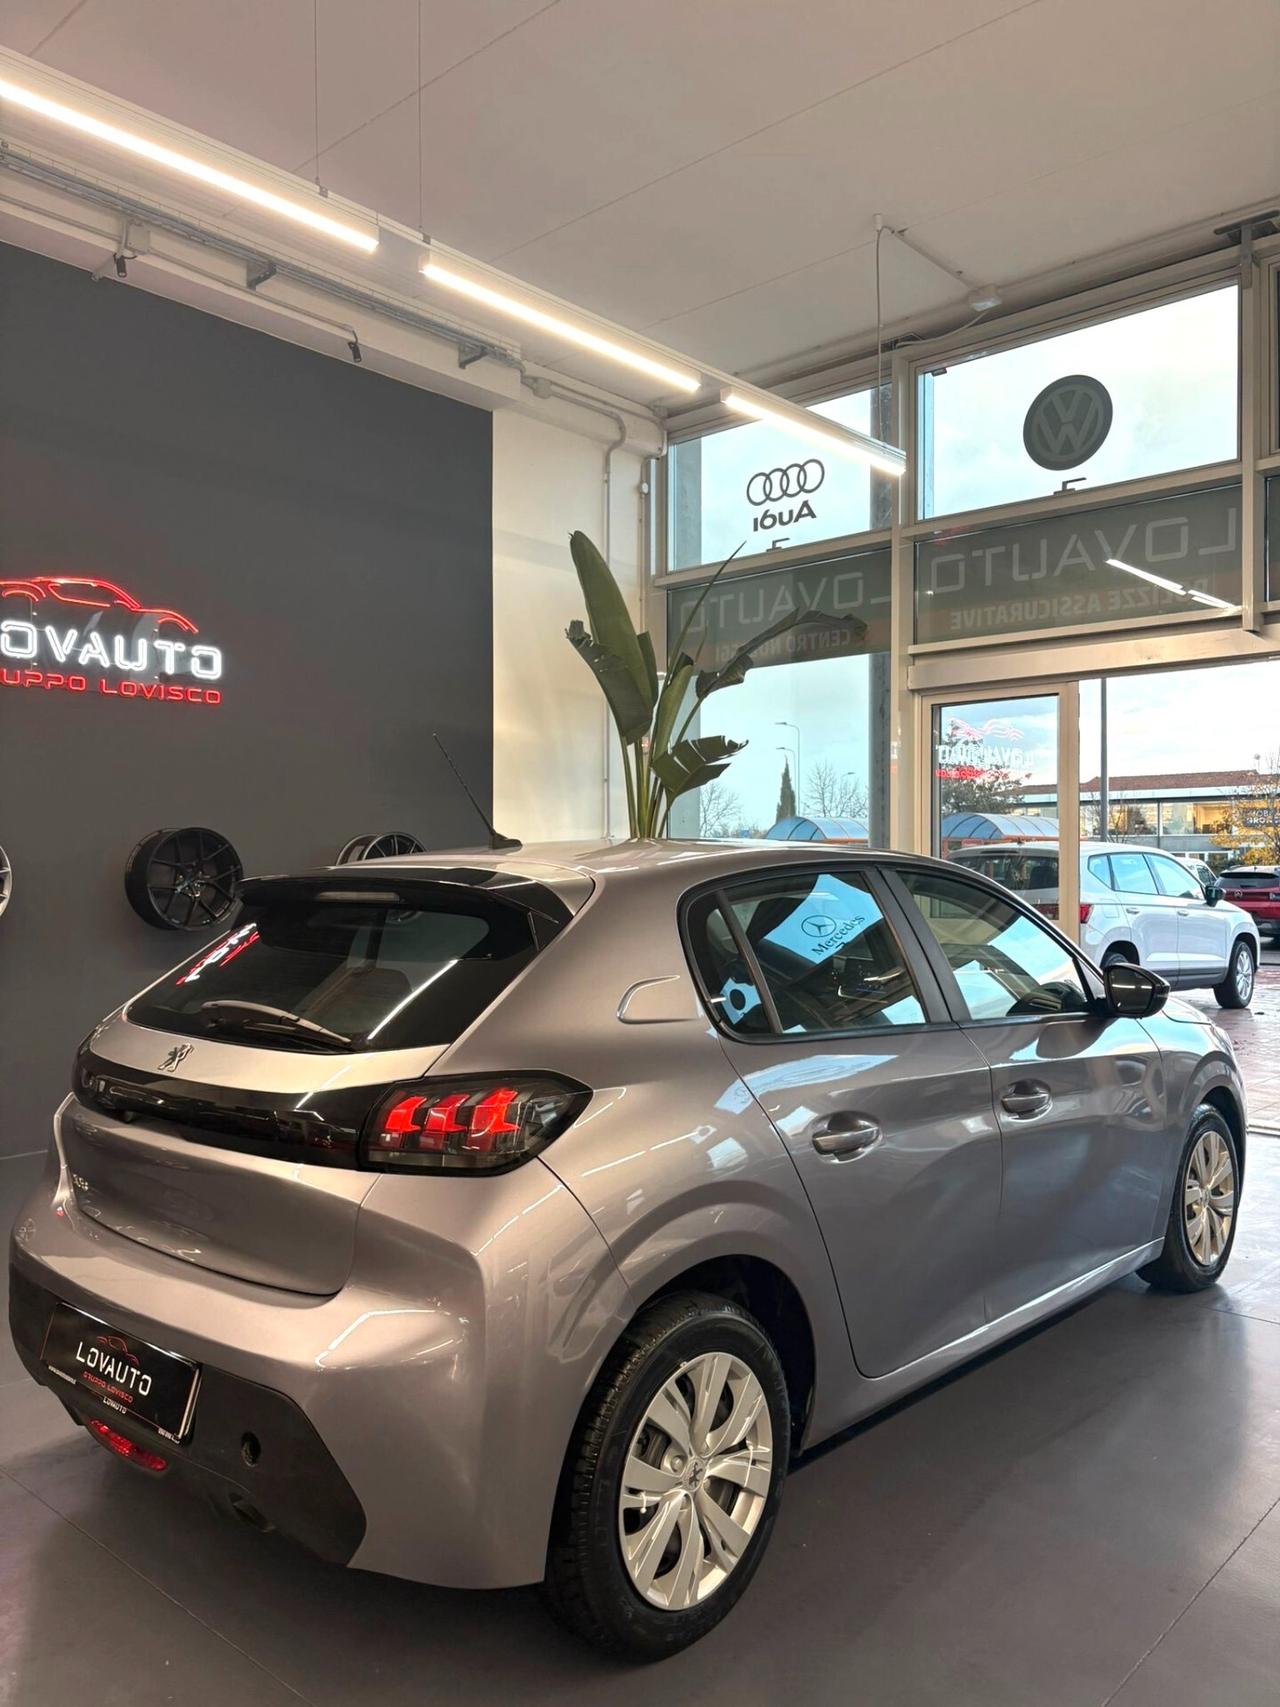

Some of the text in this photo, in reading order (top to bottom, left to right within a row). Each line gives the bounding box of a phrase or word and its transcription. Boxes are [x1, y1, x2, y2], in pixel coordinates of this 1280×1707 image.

[99, 678, 222, 704] LOVISCO
[812, 915, 865, 955] Mercedes
[75, 1341, 153, 1397] LOVAUTO
